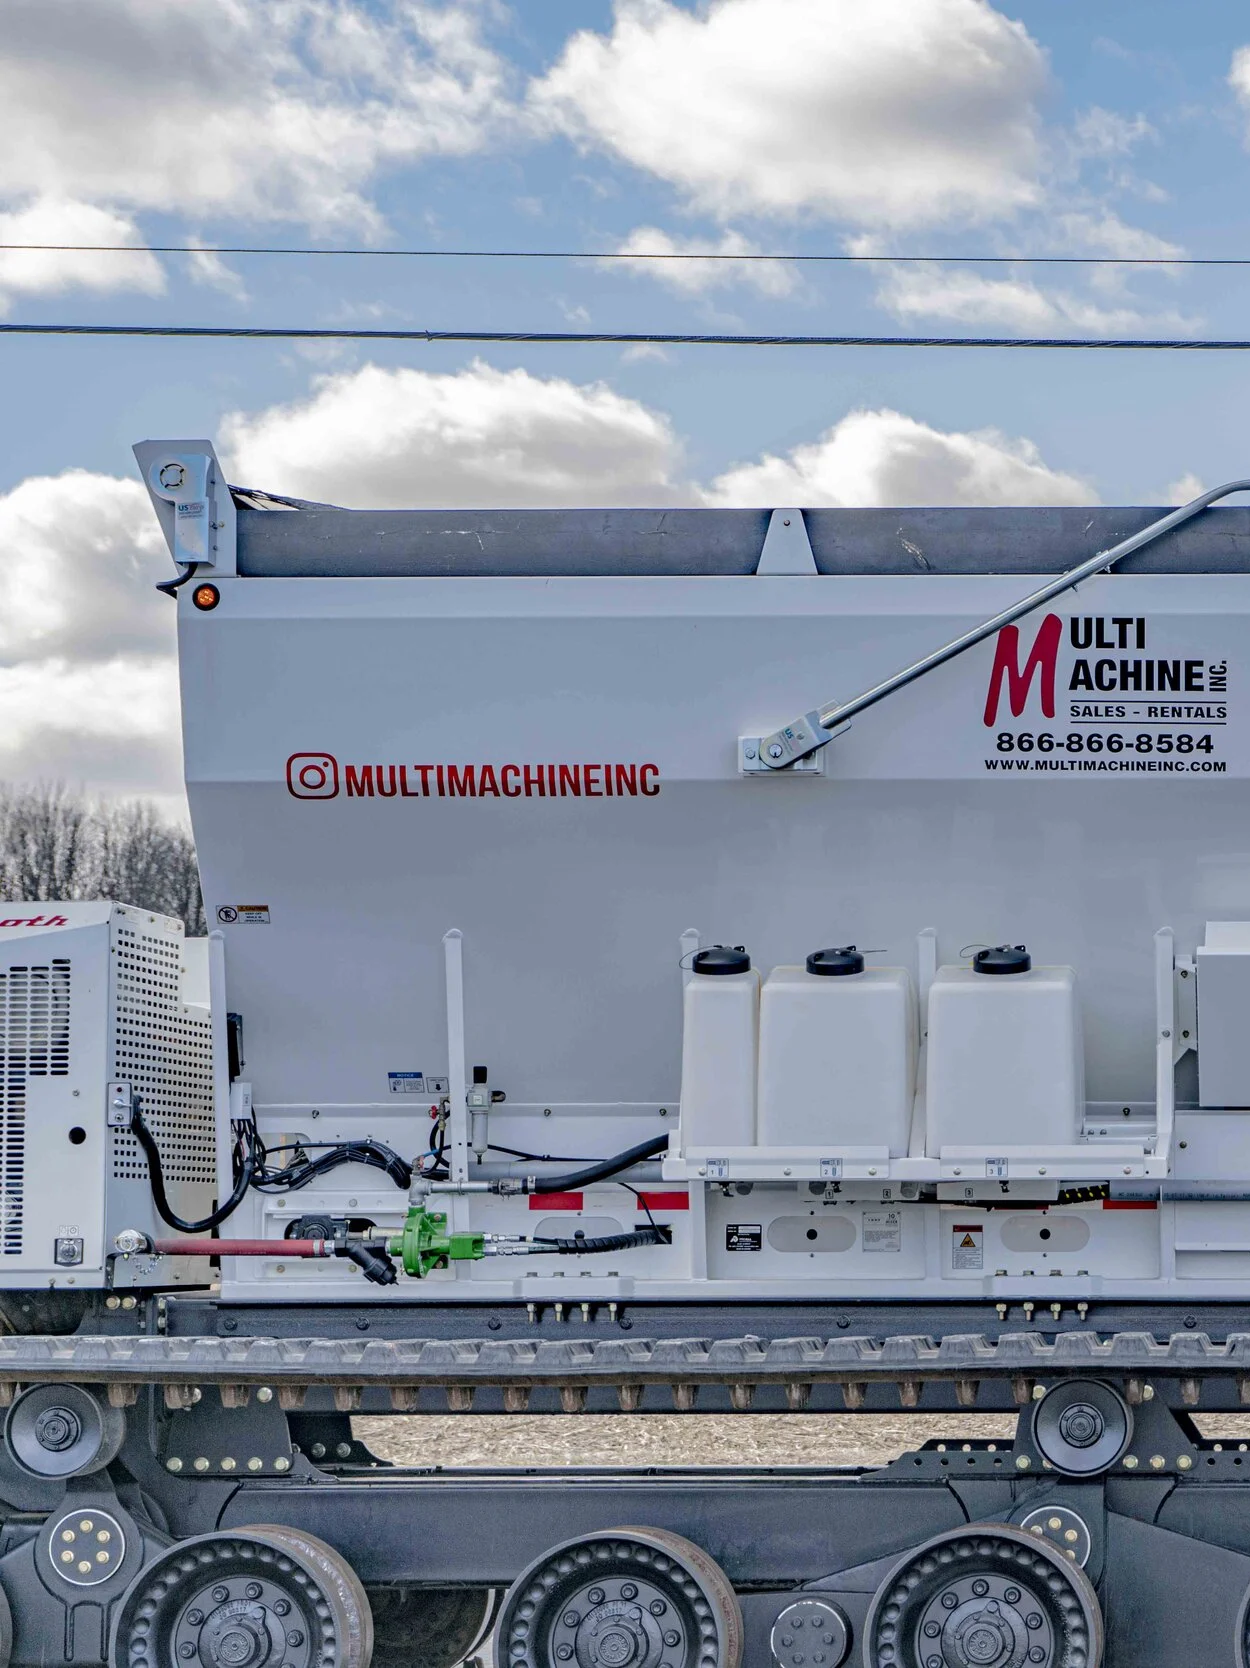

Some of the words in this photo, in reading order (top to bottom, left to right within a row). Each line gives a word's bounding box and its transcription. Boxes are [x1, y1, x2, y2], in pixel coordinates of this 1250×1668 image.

[1209, 660, 1227, 692] INC.
[1070, 705, 1126, 718] SALES
[1148, 706, 1227, 718] RENTALS
[996, 732, 1214, 754] 866-866-8584
[985, 760, 1227, 772] WWW.MULTIMACHINEINC.COM
[345, 763, 660, 798] MULTIMACHINEINC
